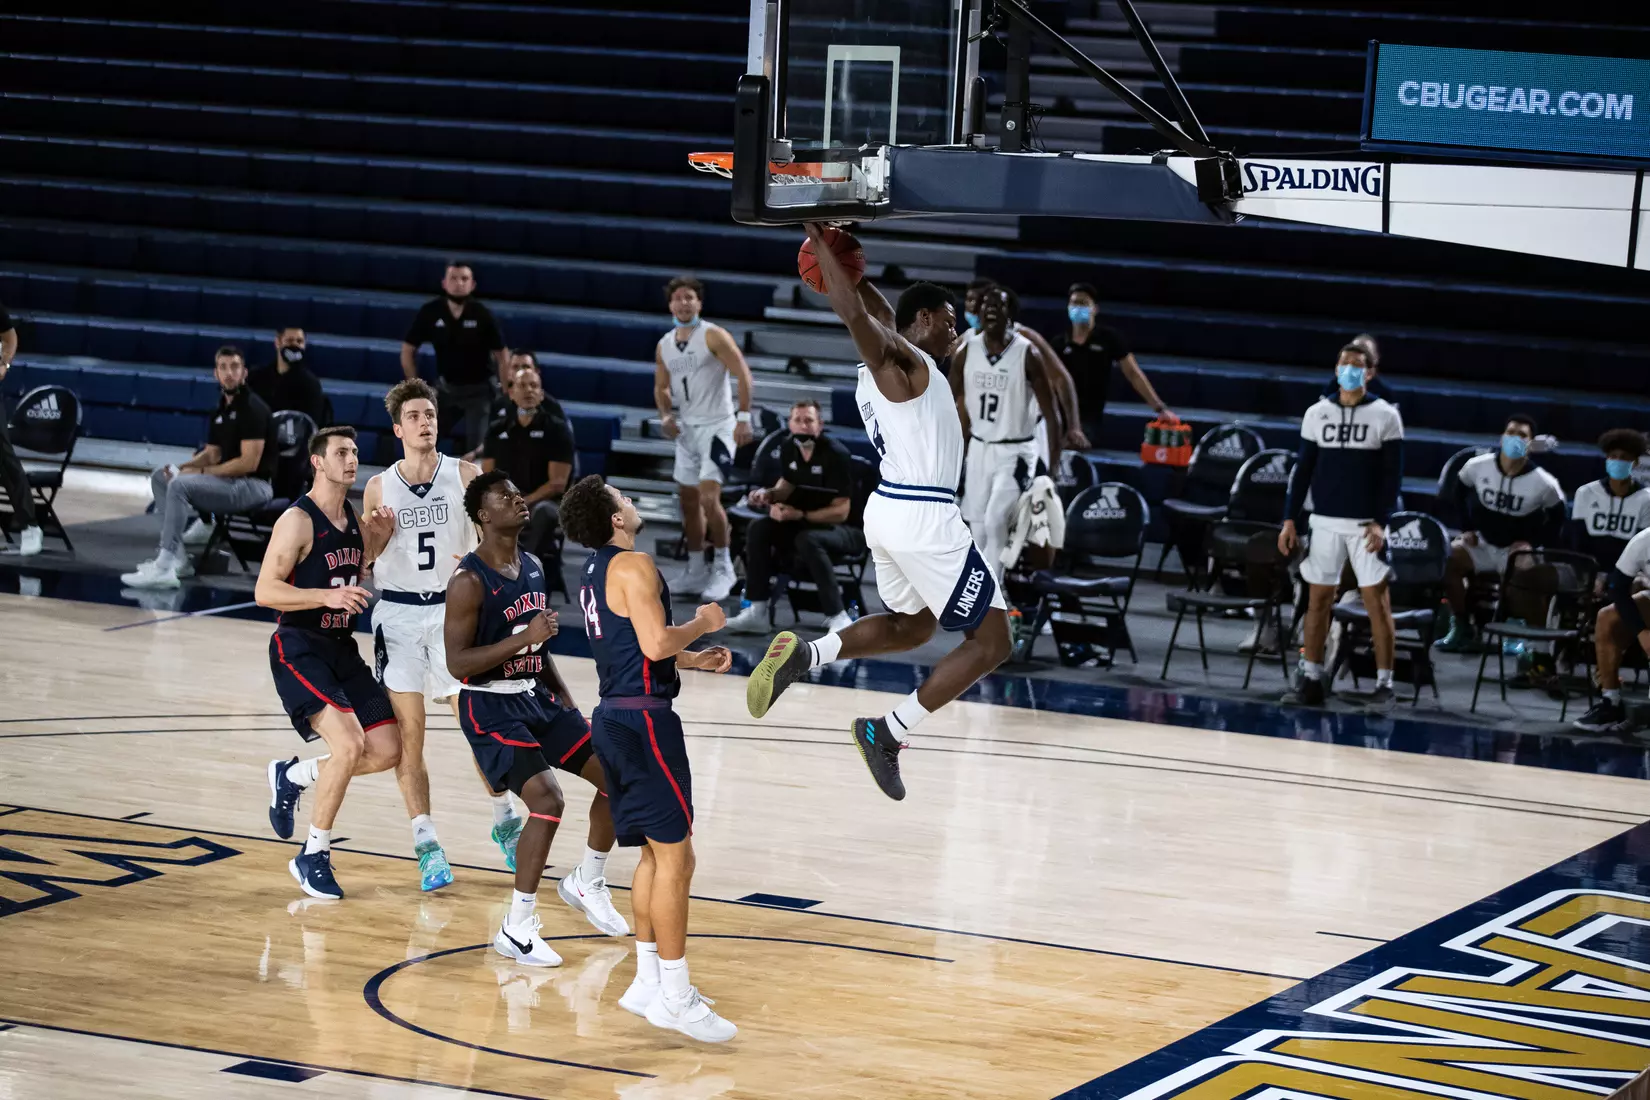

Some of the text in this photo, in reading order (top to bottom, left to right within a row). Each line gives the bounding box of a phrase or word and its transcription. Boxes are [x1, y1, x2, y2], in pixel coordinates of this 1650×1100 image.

[1397, 81, 1634, 121] CBUGEAR.COM
[1242, 162, 1382, 198] SPALDING
[980, 393, 999, 422] 12
[1322, 423, 1369, 443] CBU
[1482, 487, 1525, 512] CBU
[398, 503, 448, 529] CBU
[1083, 508, 1126, 519] adidas
[1592, 511, 1635, 534] CBU
[418, 531, 436, 571] 5
[1390, 538, 1428, 550] didas
[325, 547, 362, 570] DIXIE
[953, 567, 985, 618] LANCERS
[503, 591, 546, 621] DIXIE
